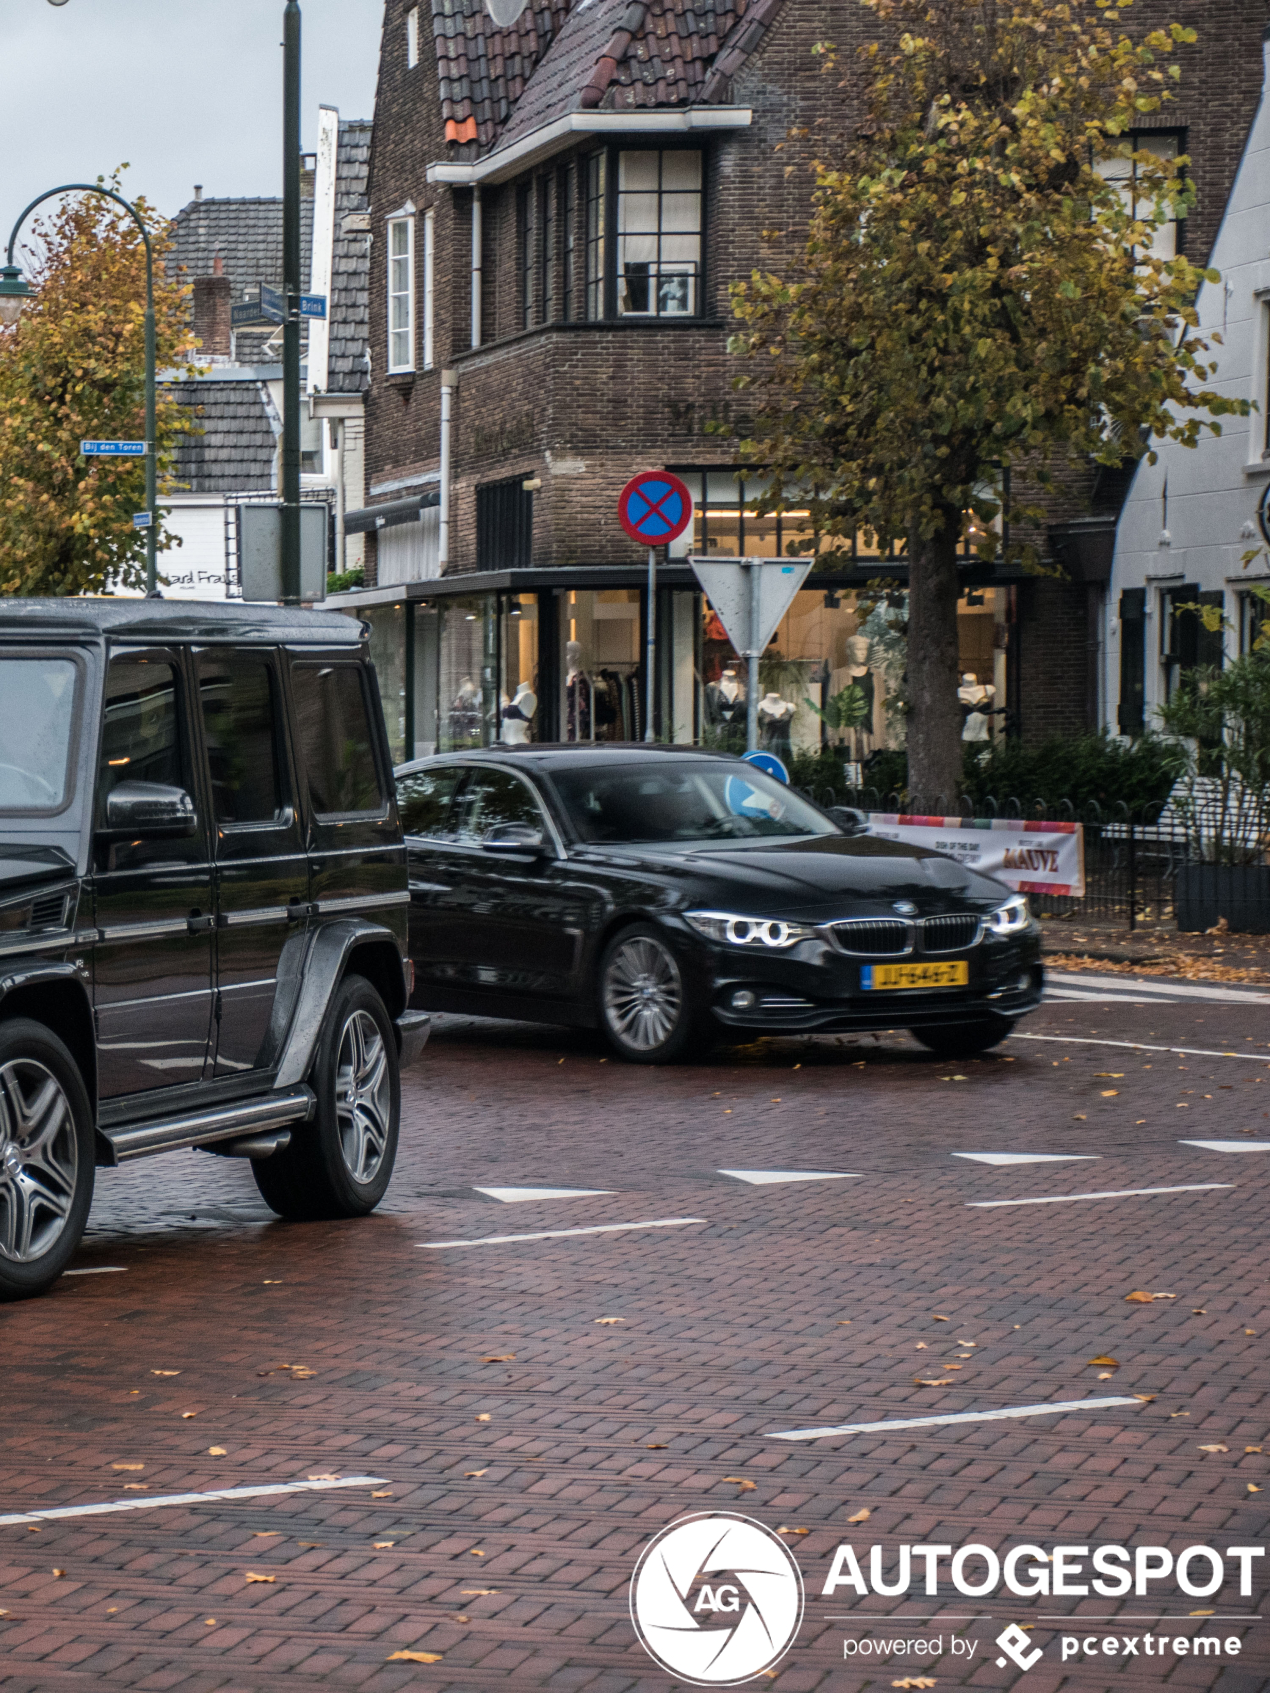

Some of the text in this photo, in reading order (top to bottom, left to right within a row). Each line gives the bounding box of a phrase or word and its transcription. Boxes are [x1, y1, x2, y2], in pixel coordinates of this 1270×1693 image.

[301, 300, 322, 313] Brink
[84, 443, 142, 452] Bij den Toren
[1002, 848, 1059, 873] MAUVE
